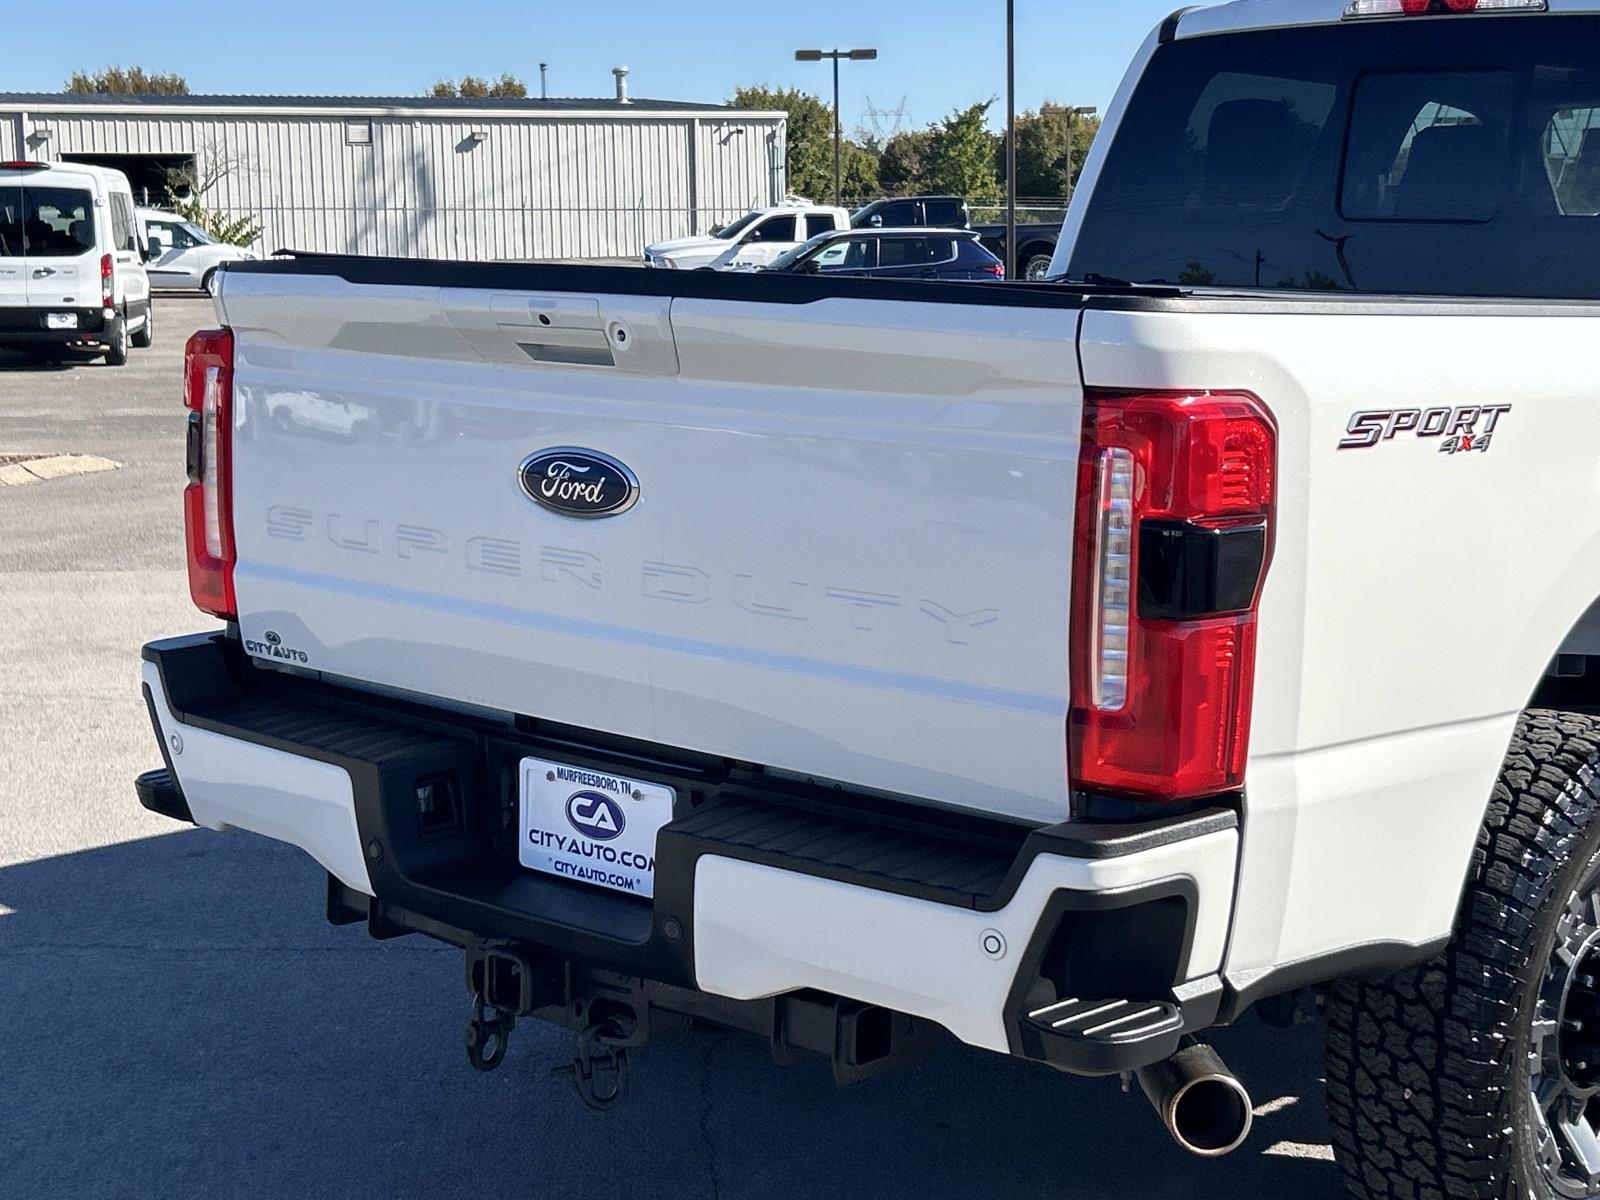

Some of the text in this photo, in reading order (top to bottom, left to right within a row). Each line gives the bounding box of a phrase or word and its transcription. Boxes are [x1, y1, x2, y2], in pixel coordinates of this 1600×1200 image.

[1337, 403, 1512, 450] SPORT
[541, 461, 606, 503] Ford
[267, 504, 1000, 646] SUPER DUTY
[245, 639, 308, 663] CITYAUTO
[556, 766, 631, 795] MURFREESBORO, TN
[571, 797, 617, 831] CA
[554, 860, 635, 890] CITYAUTO.COM
